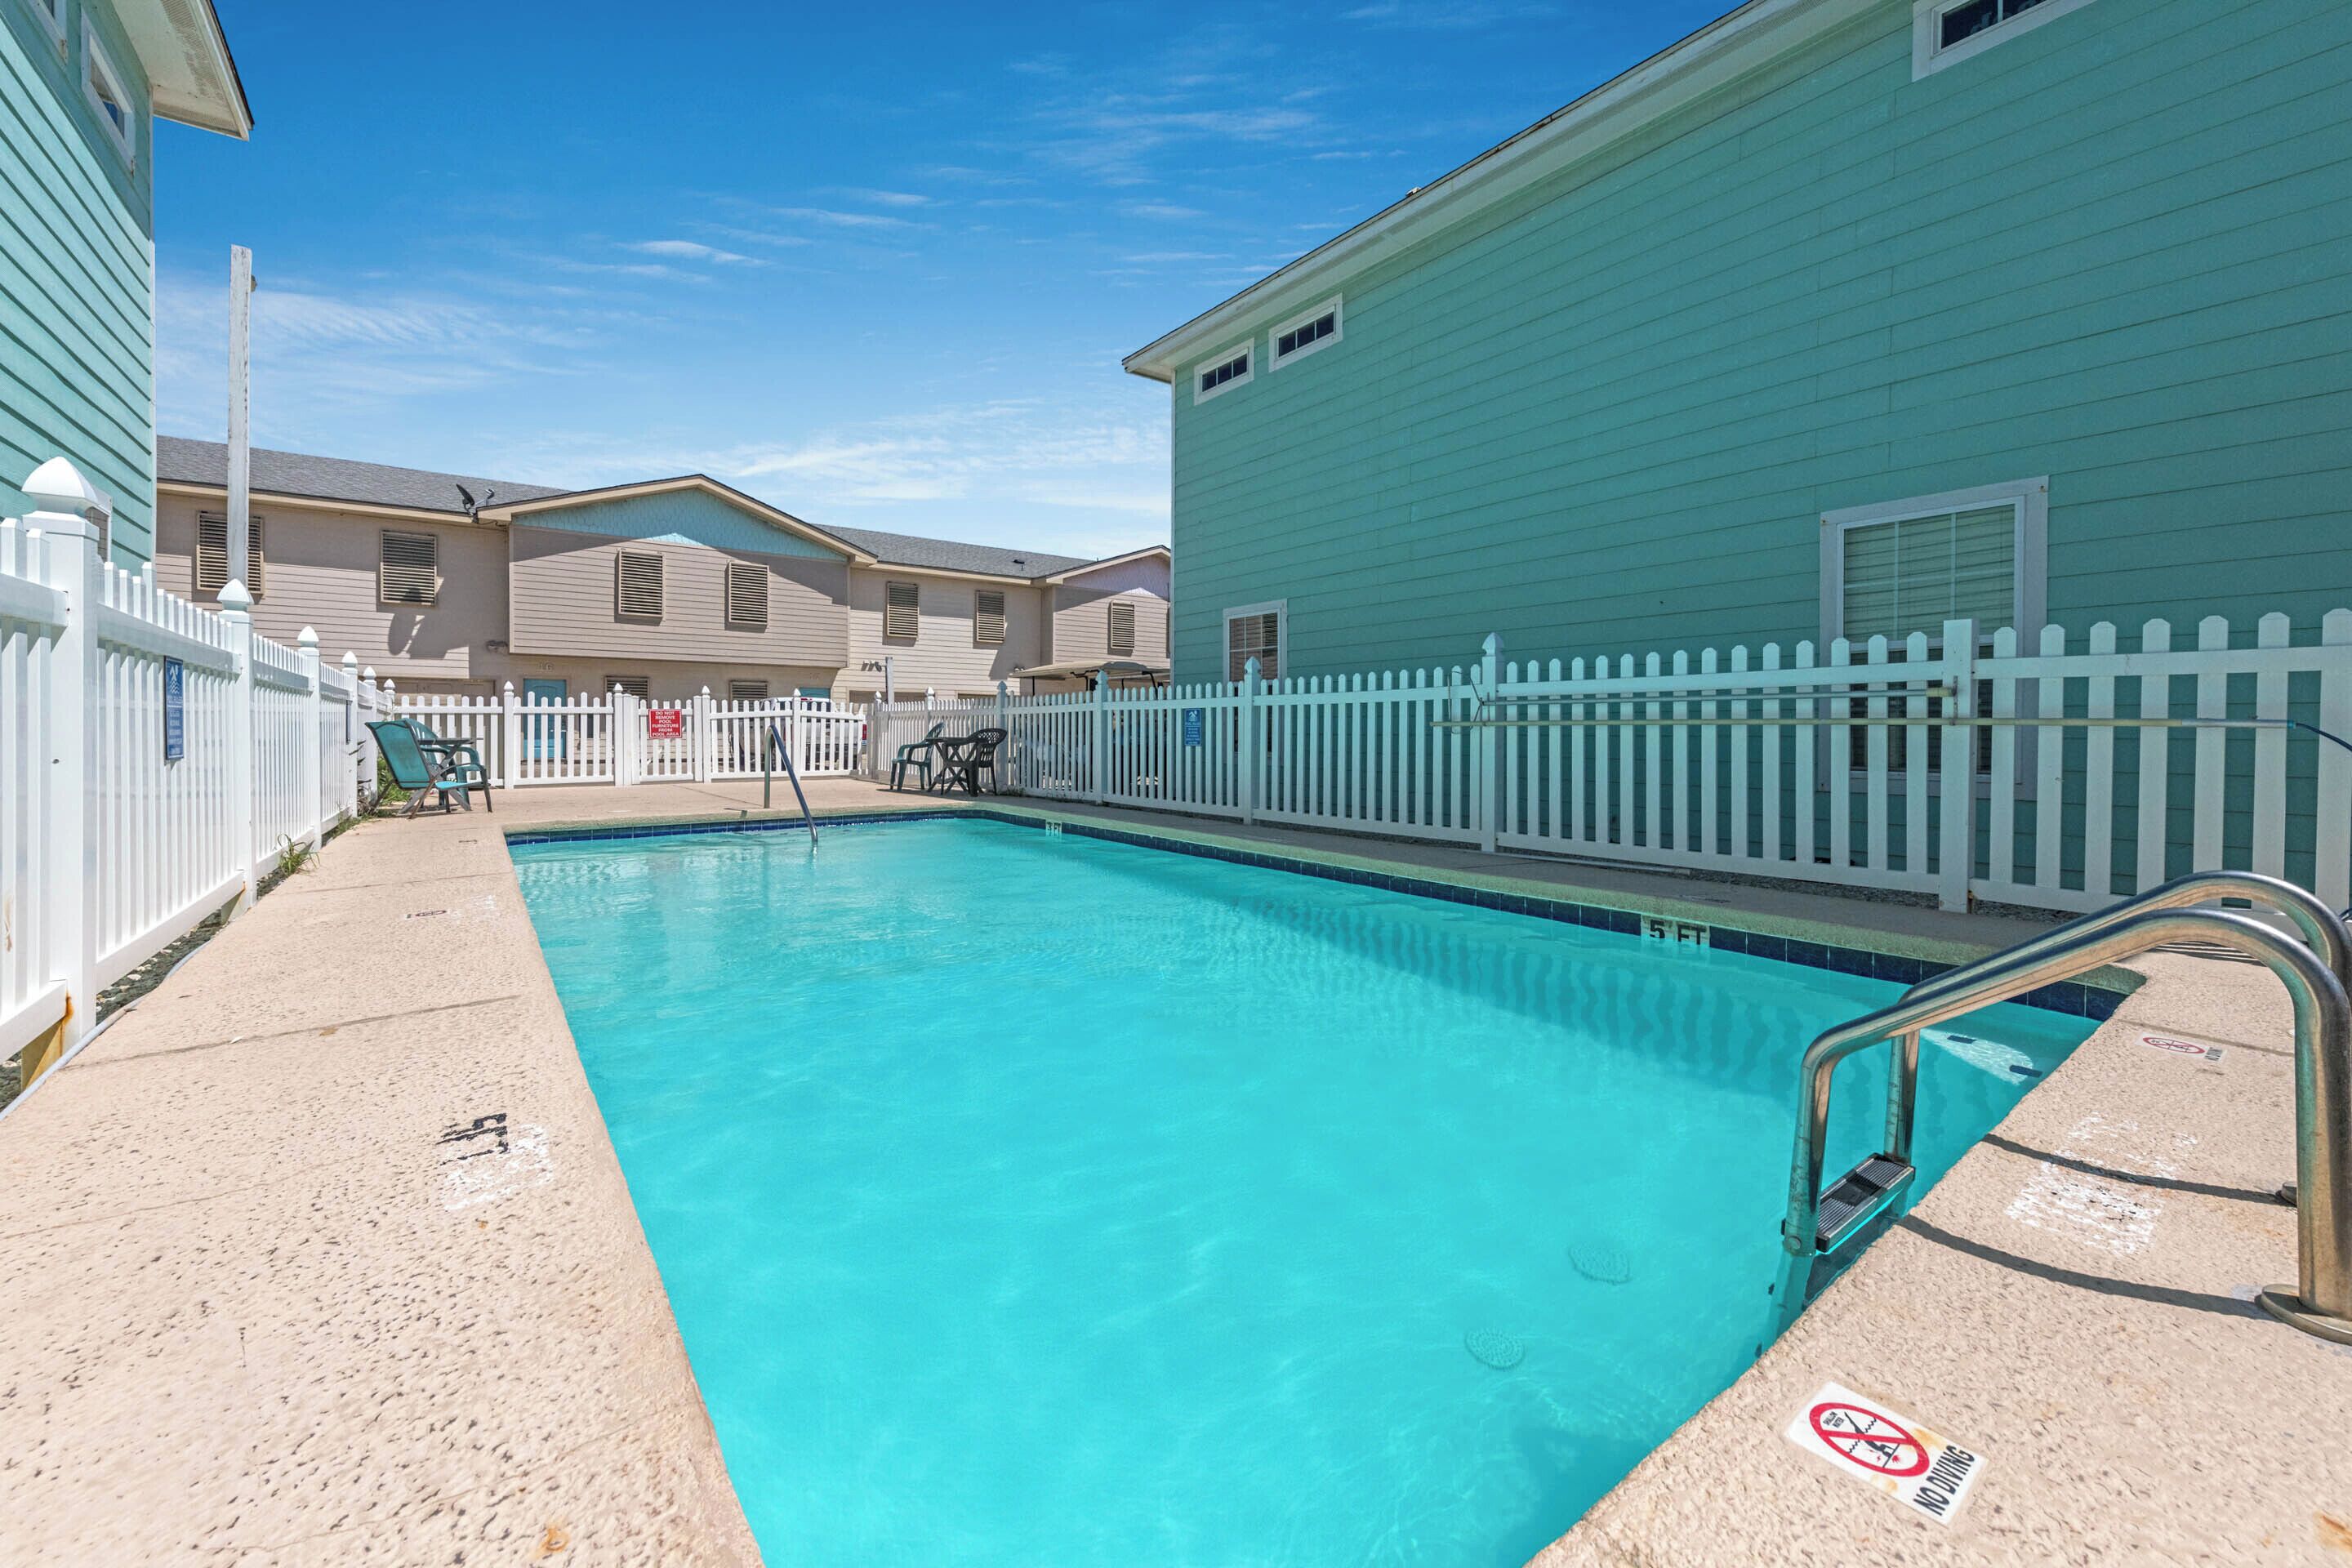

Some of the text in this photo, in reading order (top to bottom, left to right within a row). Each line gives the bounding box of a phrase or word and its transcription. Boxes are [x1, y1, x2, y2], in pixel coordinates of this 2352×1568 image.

[1650, 919, 1707, 946] 5 FT
[1832, 1416, 1845, 1428] WATER
[1913, 1445, 1975, 1517] NO DIVING
